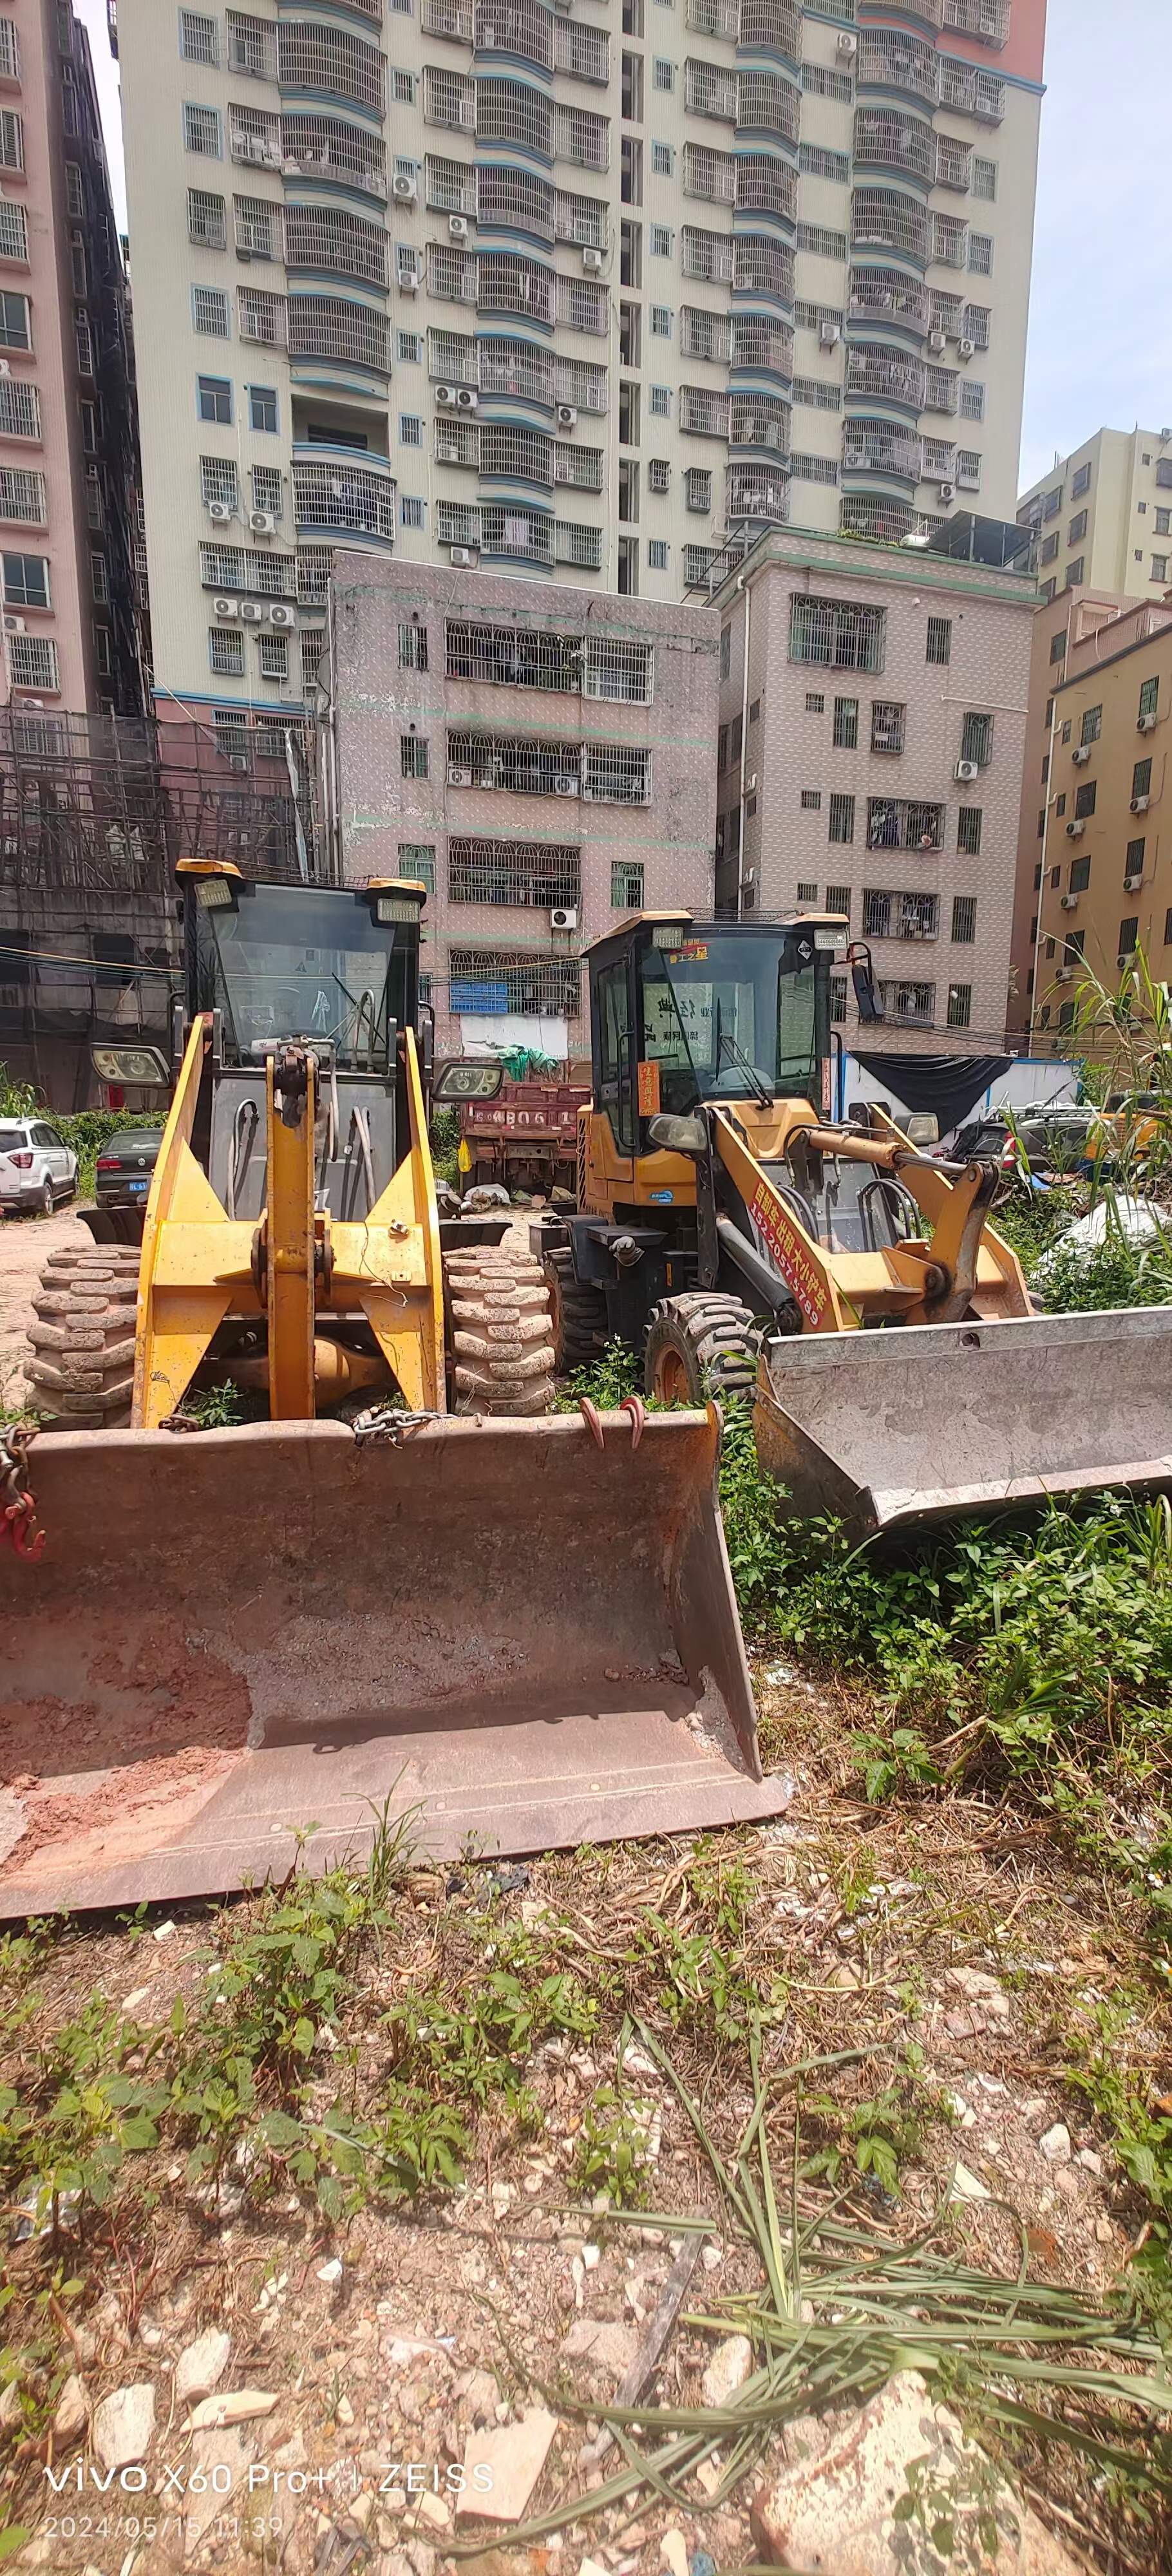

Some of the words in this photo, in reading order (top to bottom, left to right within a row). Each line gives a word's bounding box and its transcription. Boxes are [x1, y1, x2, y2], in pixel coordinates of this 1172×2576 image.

[751, 1202, 768, 1236] 152
[768, 1233, 793, 1276] 2057
[790, 1277, 818, 1325] 5789
[755, 1182, 779, 1228] 自卸车
[776, 1219, 796, 1257] 出租
